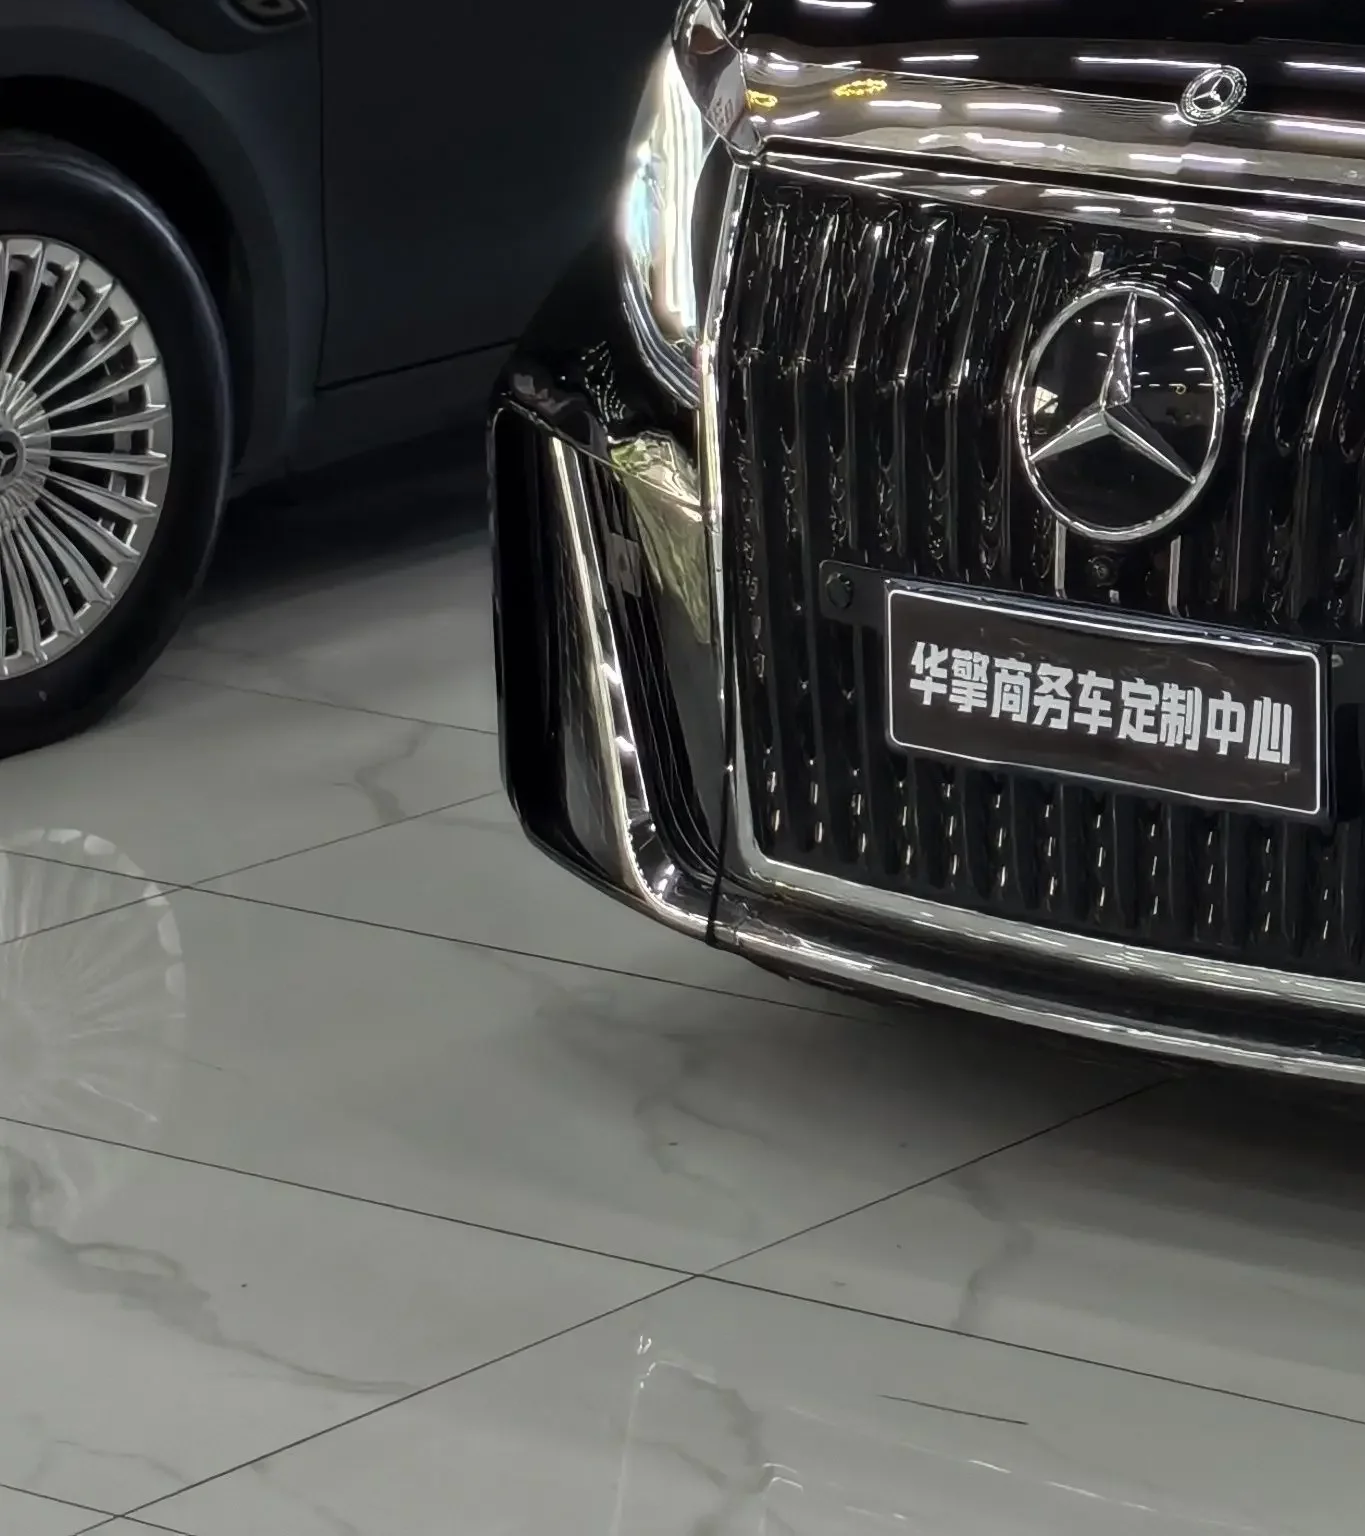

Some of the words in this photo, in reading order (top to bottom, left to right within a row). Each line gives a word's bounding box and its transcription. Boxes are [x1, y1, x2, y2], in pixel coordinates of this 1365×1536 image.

[909, 639, 1293, 765] 华擎商务车定制中心
